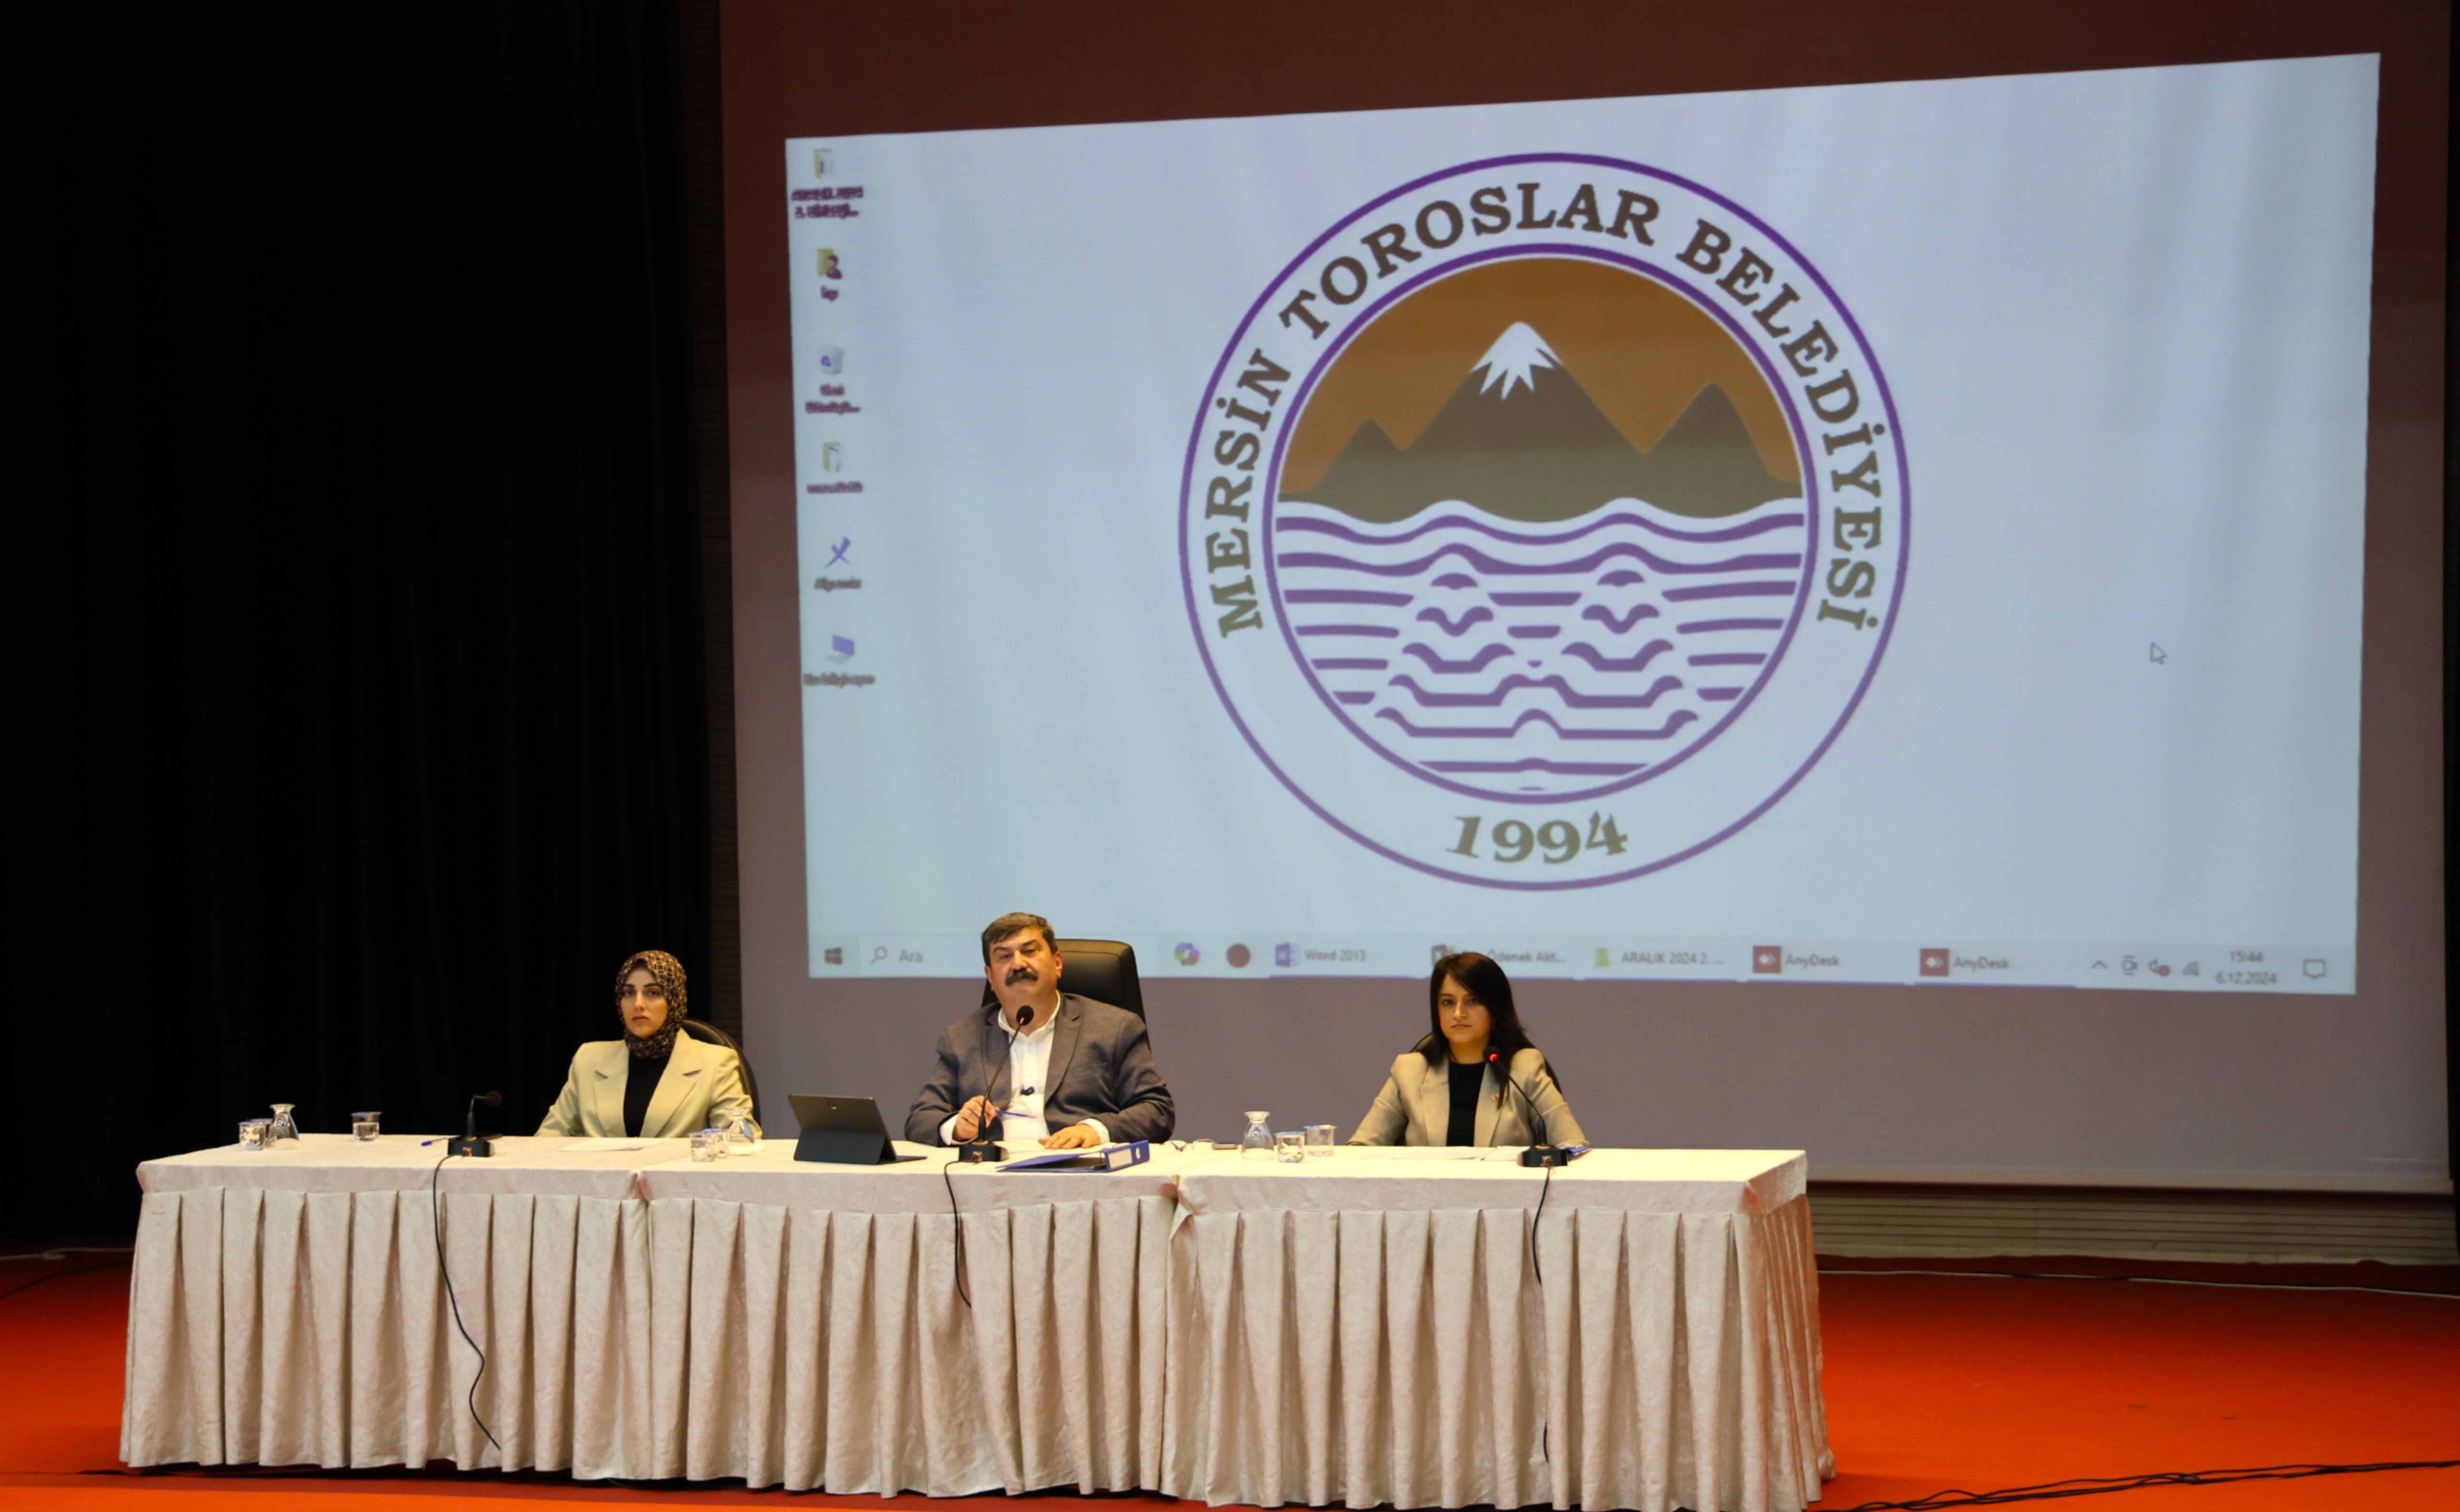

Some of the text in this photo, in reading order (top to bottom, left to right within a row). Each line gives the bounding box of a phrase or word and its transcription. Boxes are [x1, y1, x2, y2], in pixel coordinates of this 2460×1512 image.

[1205, 183, 1885, 638] MERSİN TOROSLAR BELEDİYESİ
[1446, 811, 1628, 864] 1994
[899, 950, 923, 963] Ara
[1305, 949, 1336, 961] Word
[1621, 952, 1665, 964] ARALIK
[1786, 954, 1840, 968] AnyDesk
[2230, 951, 2263, 963] 15:44
[1953, 956, 2009, 971] AnyDesk
[2215, 972, 2277, 985] 6.12.2024
